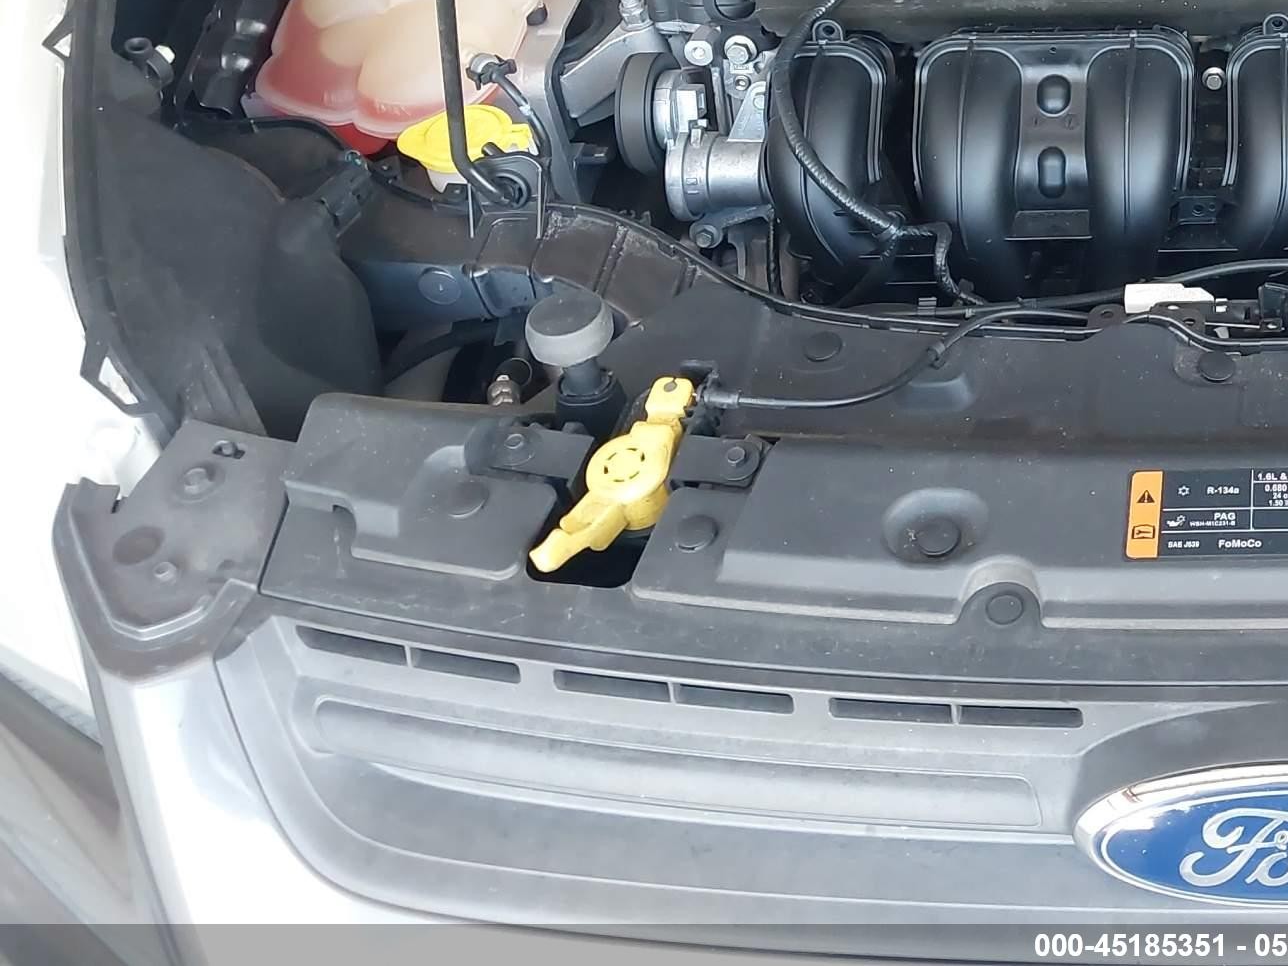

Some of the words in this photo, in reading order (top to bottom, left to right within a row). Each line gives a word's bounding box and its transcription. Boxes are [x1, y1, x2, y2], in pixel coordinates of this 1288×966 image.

[1279, 472, 1288, 481] &
[1206, 486, 1240, 495] R-134a
[1213, 512, 1237, 521] PAG
[1217, 538, 1263, 549] FoMoCo
